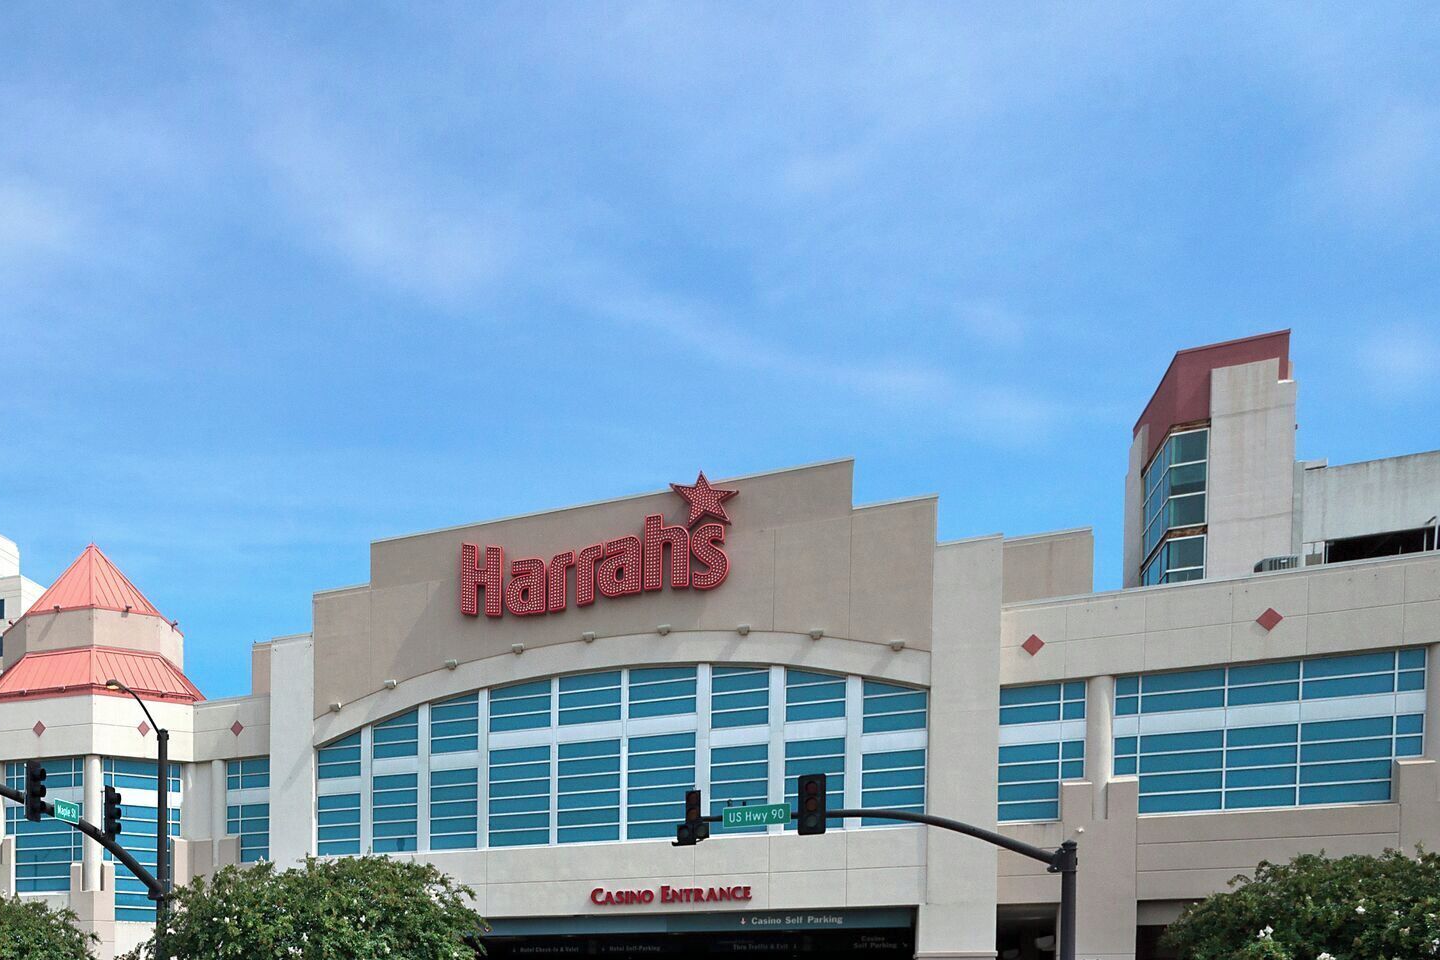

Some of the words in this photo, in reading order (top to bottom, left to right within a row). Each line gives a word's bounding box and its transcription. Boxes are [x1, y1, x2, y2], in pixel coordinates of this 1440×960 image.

[57, 804, 71, 818] Maple
[728, 811, 742, 823] US
[745, 811, 768, 823] Hwy
[771, 808, 785, 820] 90
[590, 888, 655, 906] CASINO
[660, 885, 753, 904] ENTRANCE
[751, 917, 782, 925] Casino
[785, 916, 803, 925] Self
[807, 915, 844, 926] Parking
